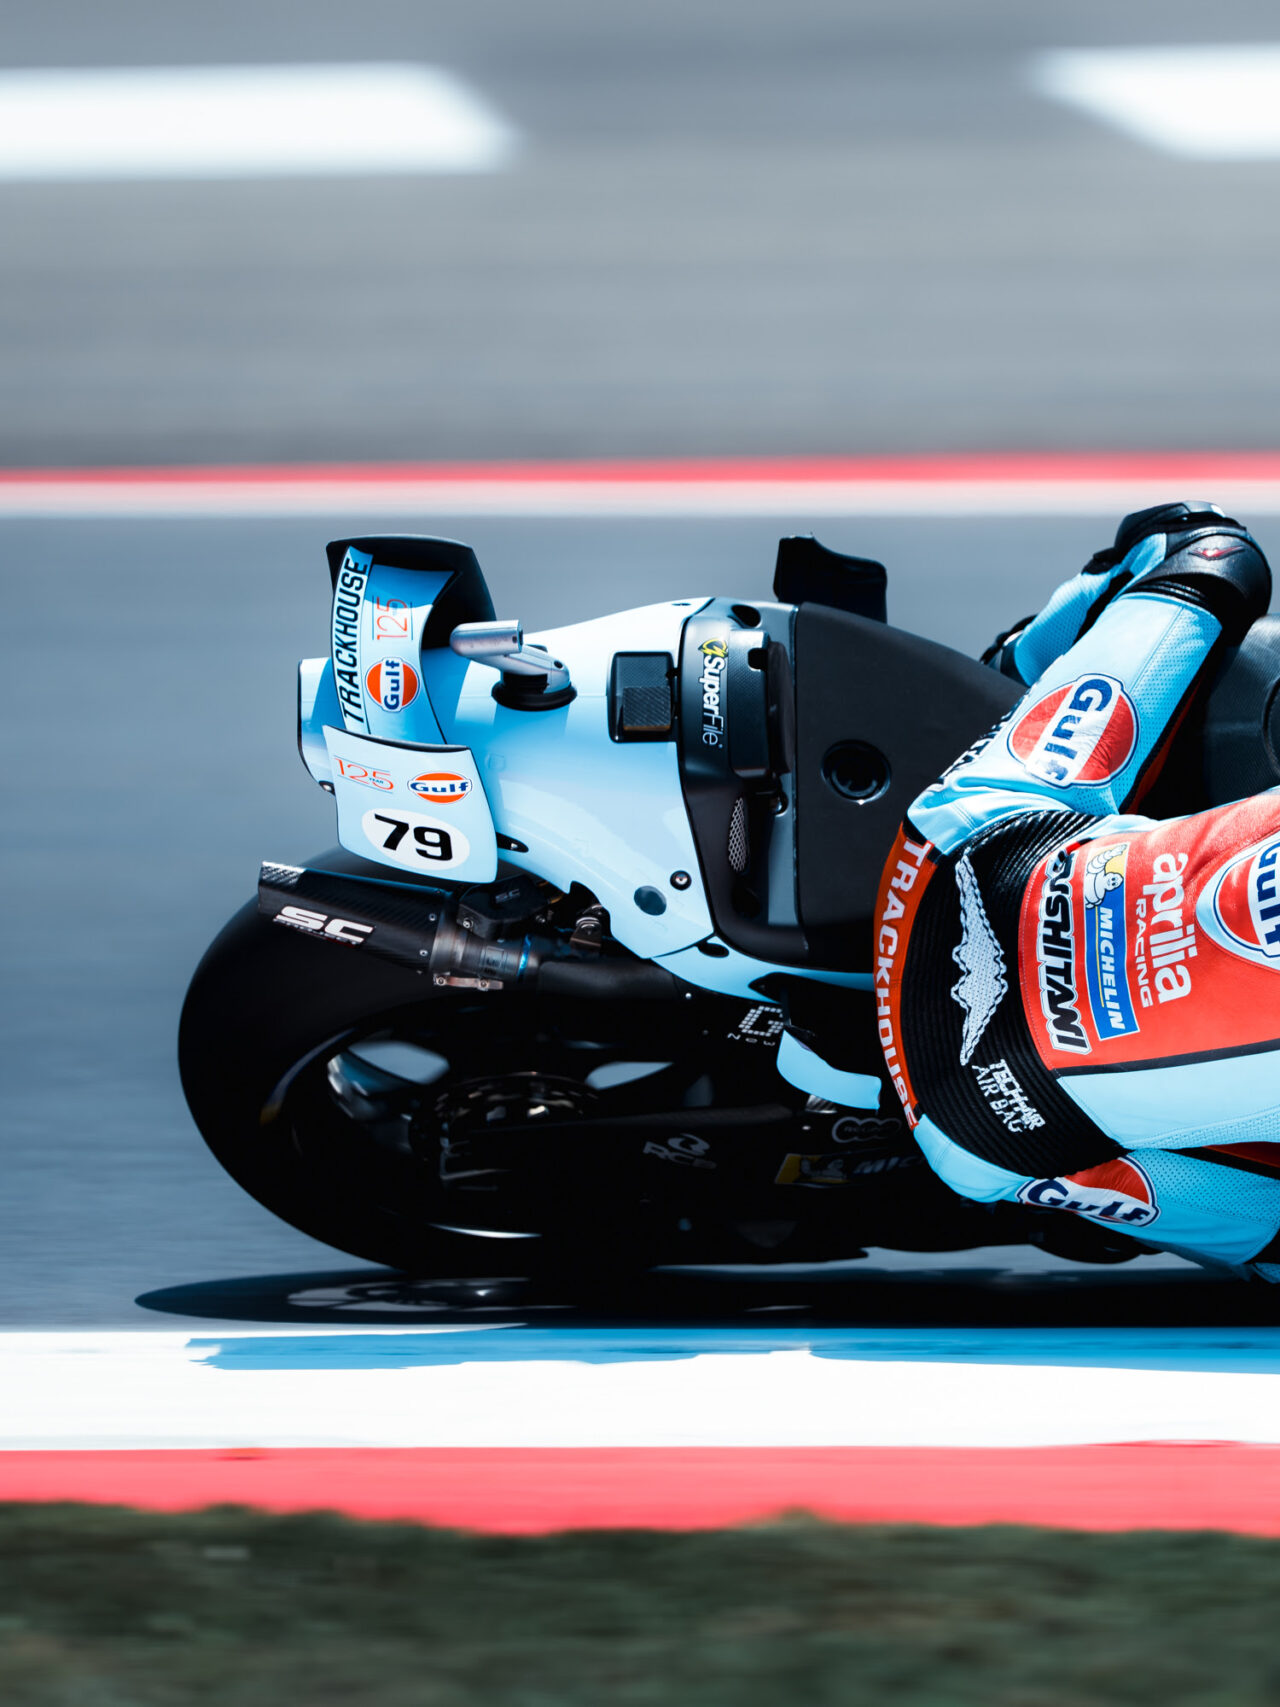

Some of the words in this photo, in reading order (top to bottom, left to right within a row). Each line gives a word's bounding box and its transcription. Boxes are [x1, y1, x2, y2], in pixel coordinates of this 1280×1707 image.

[334, 557, 369, 723] TRACKHOUSE
[376, 595, 408, 641] 125
[383, 659, 401, 711] Gulf
[699, 654, 724, 746] SuperFile
[1035, 678, 1113, 783] Gulf
[333, 757, 395, 791] 125
[409, 781, 469, 793] Gulf
[373, 812, 453, 862] 79
[272, 905, 376, 946] SC
[1134, 897, 1154, 1008] RACING
[1142, 852, 1198, 1004] aprilia
[876, 836, 933, 1129] TRACKHOUSE
[1099, 906, 1126, 1030] MICHELIN
[1026, 1178, 1151, 1221] Gulf
